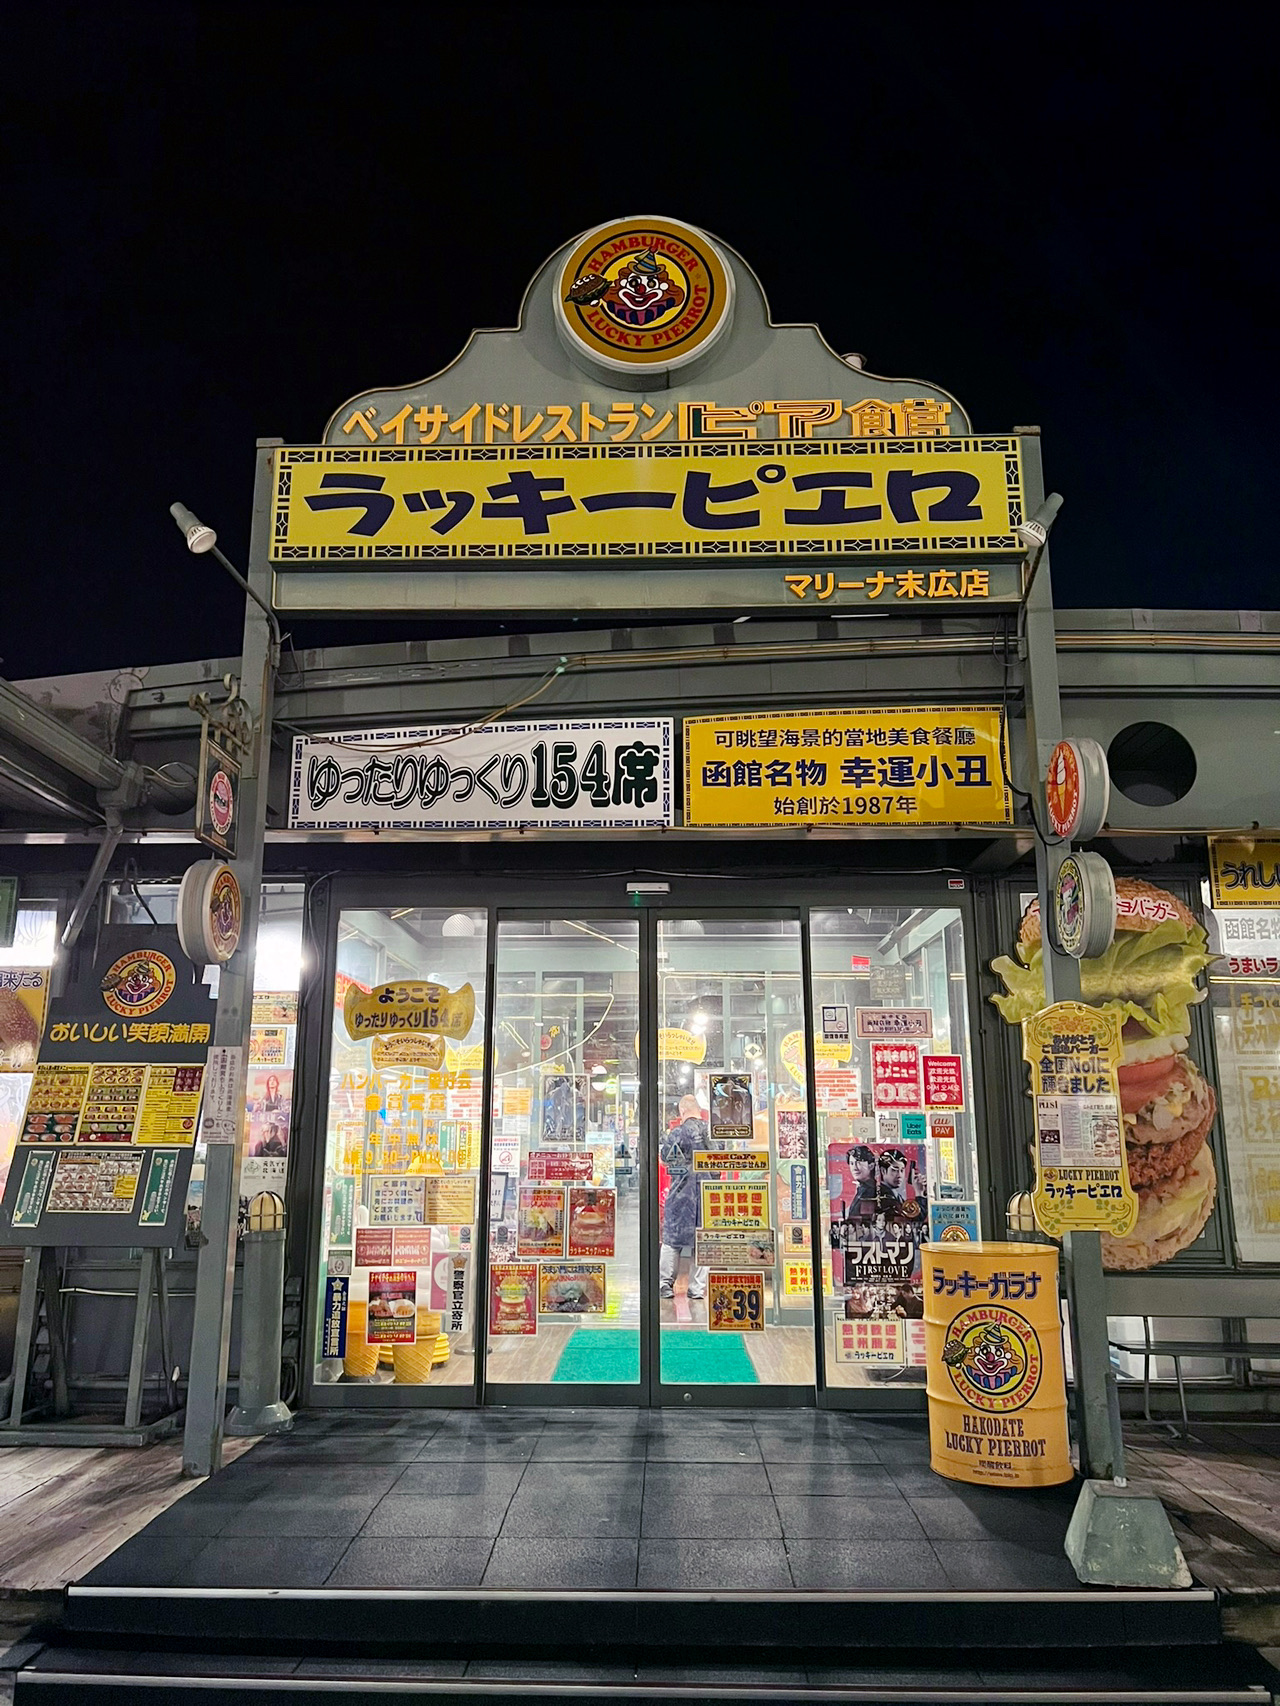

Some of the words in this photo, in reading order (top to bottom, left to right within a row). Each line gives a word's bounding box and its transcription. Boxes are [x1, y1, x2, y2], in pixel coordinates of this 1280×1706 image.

[588, 235, 698, 273] HAMBURGER
[587, 310, 646, 347] LUCKY
[652, 284, 708, 346] PIERROT
[342, 401, 673, 444] ベイサイドレストラン
[304, 463, 984, 537] ラッキーピエロ
[784, 568, 990, 599] マリーナ末広店
[714, 726, 977, 749] 可眺望海景的當地美食餐廳
[306, 740, 661, 811] ゆったりゆっくり154席
[701, 759, 828, 788] 函館名物
[839, 754, 992, 789] 幸運小丑
[773, 795, 918, 816] 始創於1987年
[1116, 898, 1178, 920] ョバーガー
[112, 950, 173, 974] HAMBURGER
[0, 970, 43, 991] 来たる
[106, 993, 136, 1016] LUCKY
[138, 979, 174, 1015] PIERROT
[378, 987, 442, 1004] ようこそ
[49, 1023, 211, 1044] おいしい笑顔満開
[876, 1082, 918, 1103] OK
[935, 1126, 951, 1134] PAY
[1058, 1169, 1083, 1182] LUCKY
[1085, 1169, 1120, 1182] PIERROT
[1044, 1183, 1123, 1199] ラッキーピエロ
[847, 1241, 913, 1265] ラストマン
[855, 1265, 882, 1277] FIRST
[883, 1265, 909, 1278] LOVE
[932, 1266, 1042, 1300] ラッキーガラナ
[732, 1289, 761, 1321] 39
[952, 1309, 1032, 1342] HAMBURGER
[953, 1372, 995, 1409] LUCKY
[1002, 1353, 1039, 1409] PIERROT
[962, 1414, 1025, 1437] HAKODATE
[945, 1430, 983, 1454] LUCKY
[988, 1438, 1046, 1458] PIERROT
